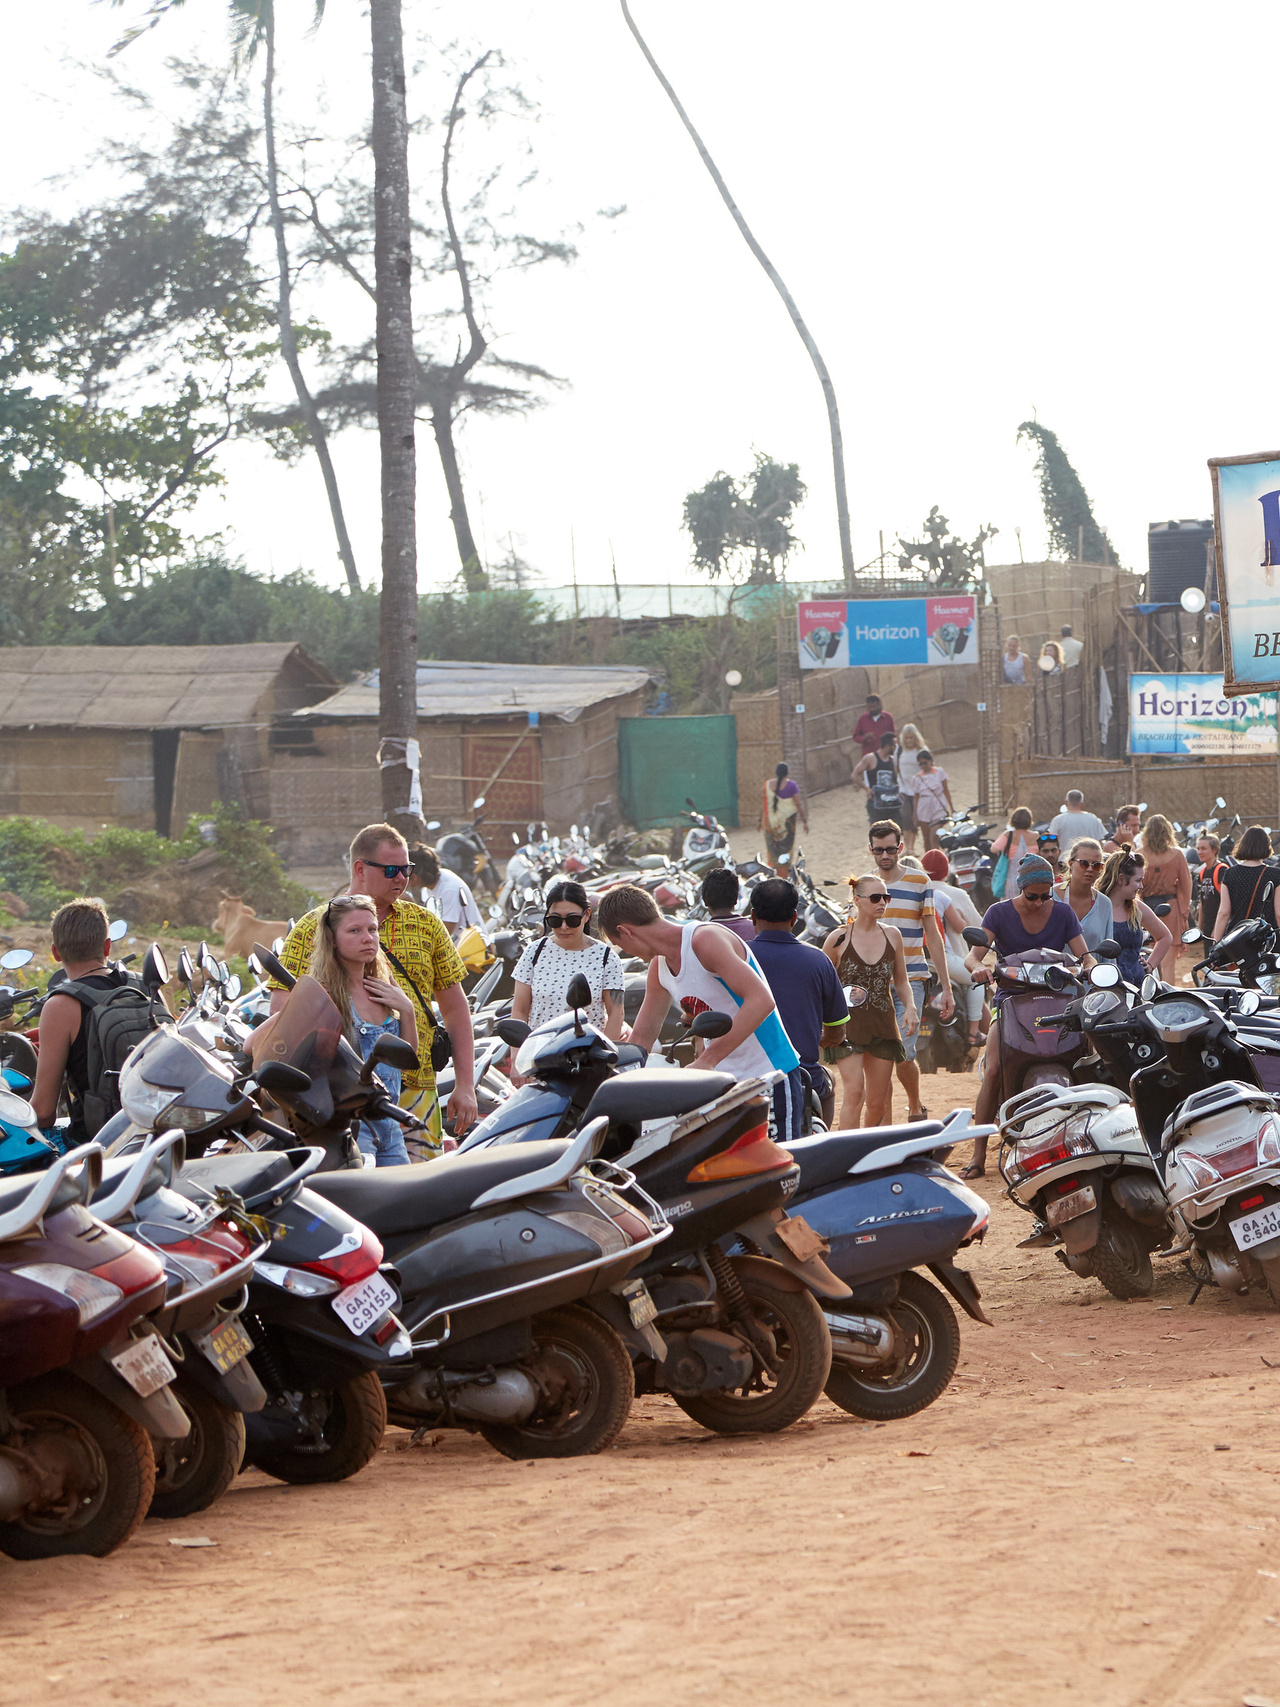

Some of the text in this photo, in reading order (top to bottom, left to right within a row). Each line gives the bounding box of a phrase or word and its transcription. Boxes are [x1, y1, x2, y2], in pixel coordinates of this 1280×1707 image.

[855, 624, 920, 641] Horizon
[1138, 692, 1248, 719] Horizon
[1138, 733, 1164, 741] BEACH
[1165, 733, 1184, 741] HUT
[1192, 733, 1245, 741] RESTAURANT
[1241, 1210, 1278, 1233] GA.11
[345, 1284, 377, 1316] GA.11
[352, 1288, 391, 1330] C.9155
